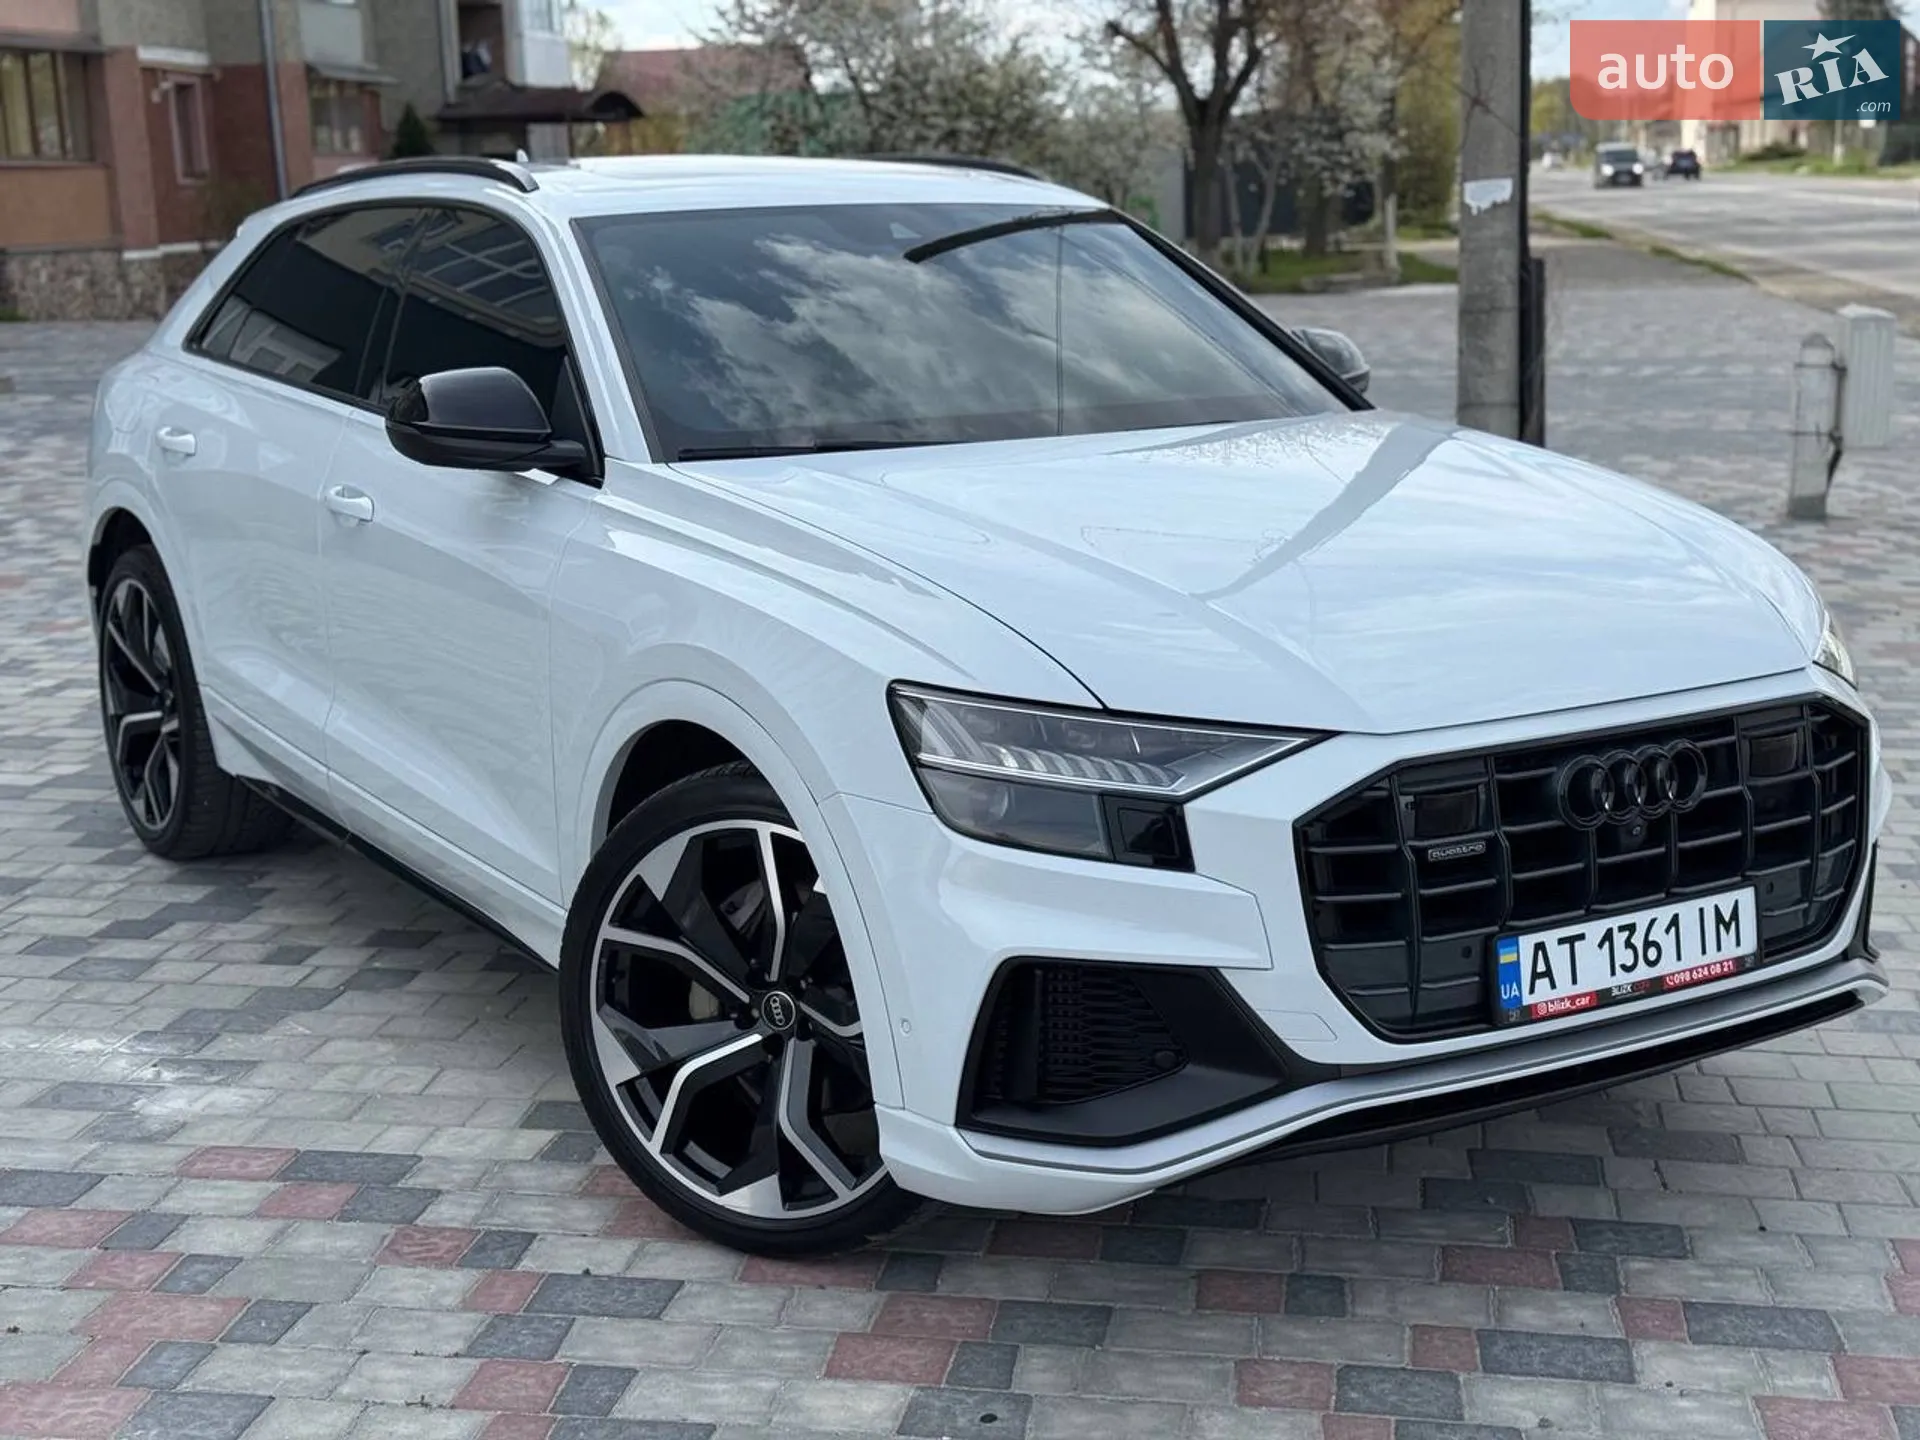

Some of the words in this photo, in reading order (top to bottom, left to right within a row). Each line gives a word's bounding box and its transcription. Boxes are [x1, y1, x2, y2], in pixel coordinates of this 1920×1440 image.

[1528, 932, 1586, 996] AT
[1597, 911, 1682, 978] 1361
[1698, 899, 1742, 957] IM
[1501, 981, 1520, 1000] UA
